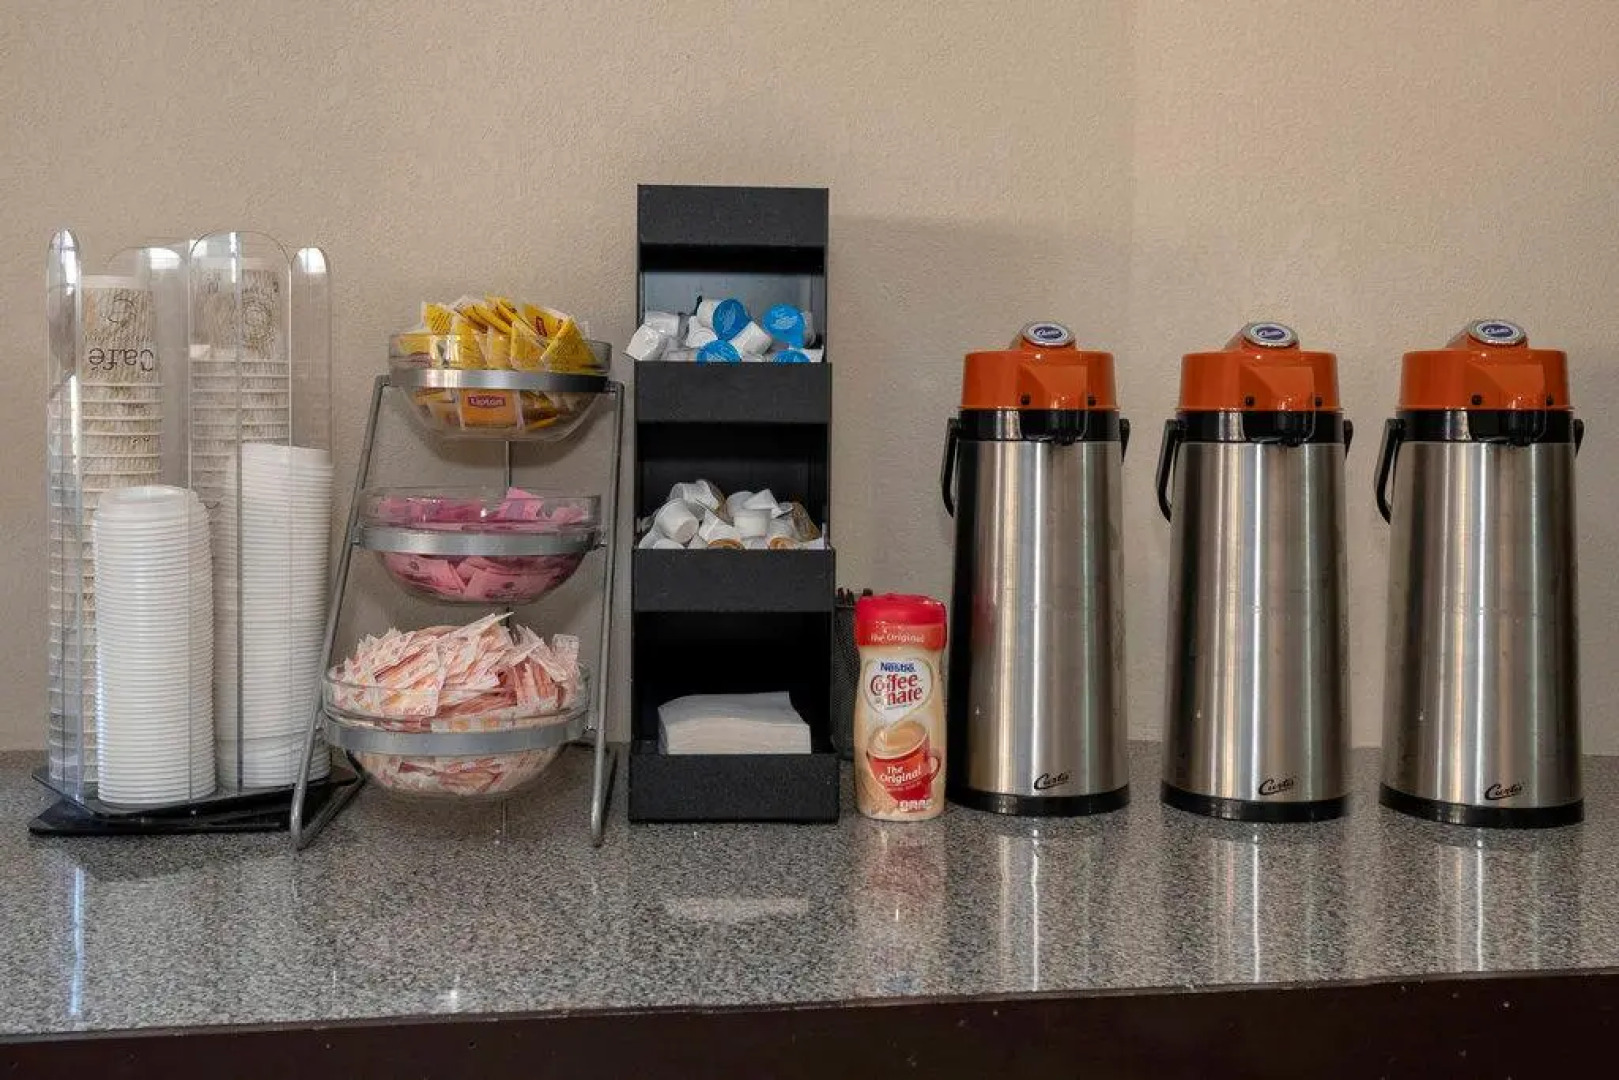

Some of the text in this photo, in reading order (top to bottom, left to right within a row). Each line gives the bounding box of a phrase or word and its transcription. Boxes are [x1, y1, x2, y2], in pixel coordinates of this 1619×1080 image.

[89, 347, 154, 372] Café
[880, 764, 922, 785] Original
[886, 765, 904, 775] The
